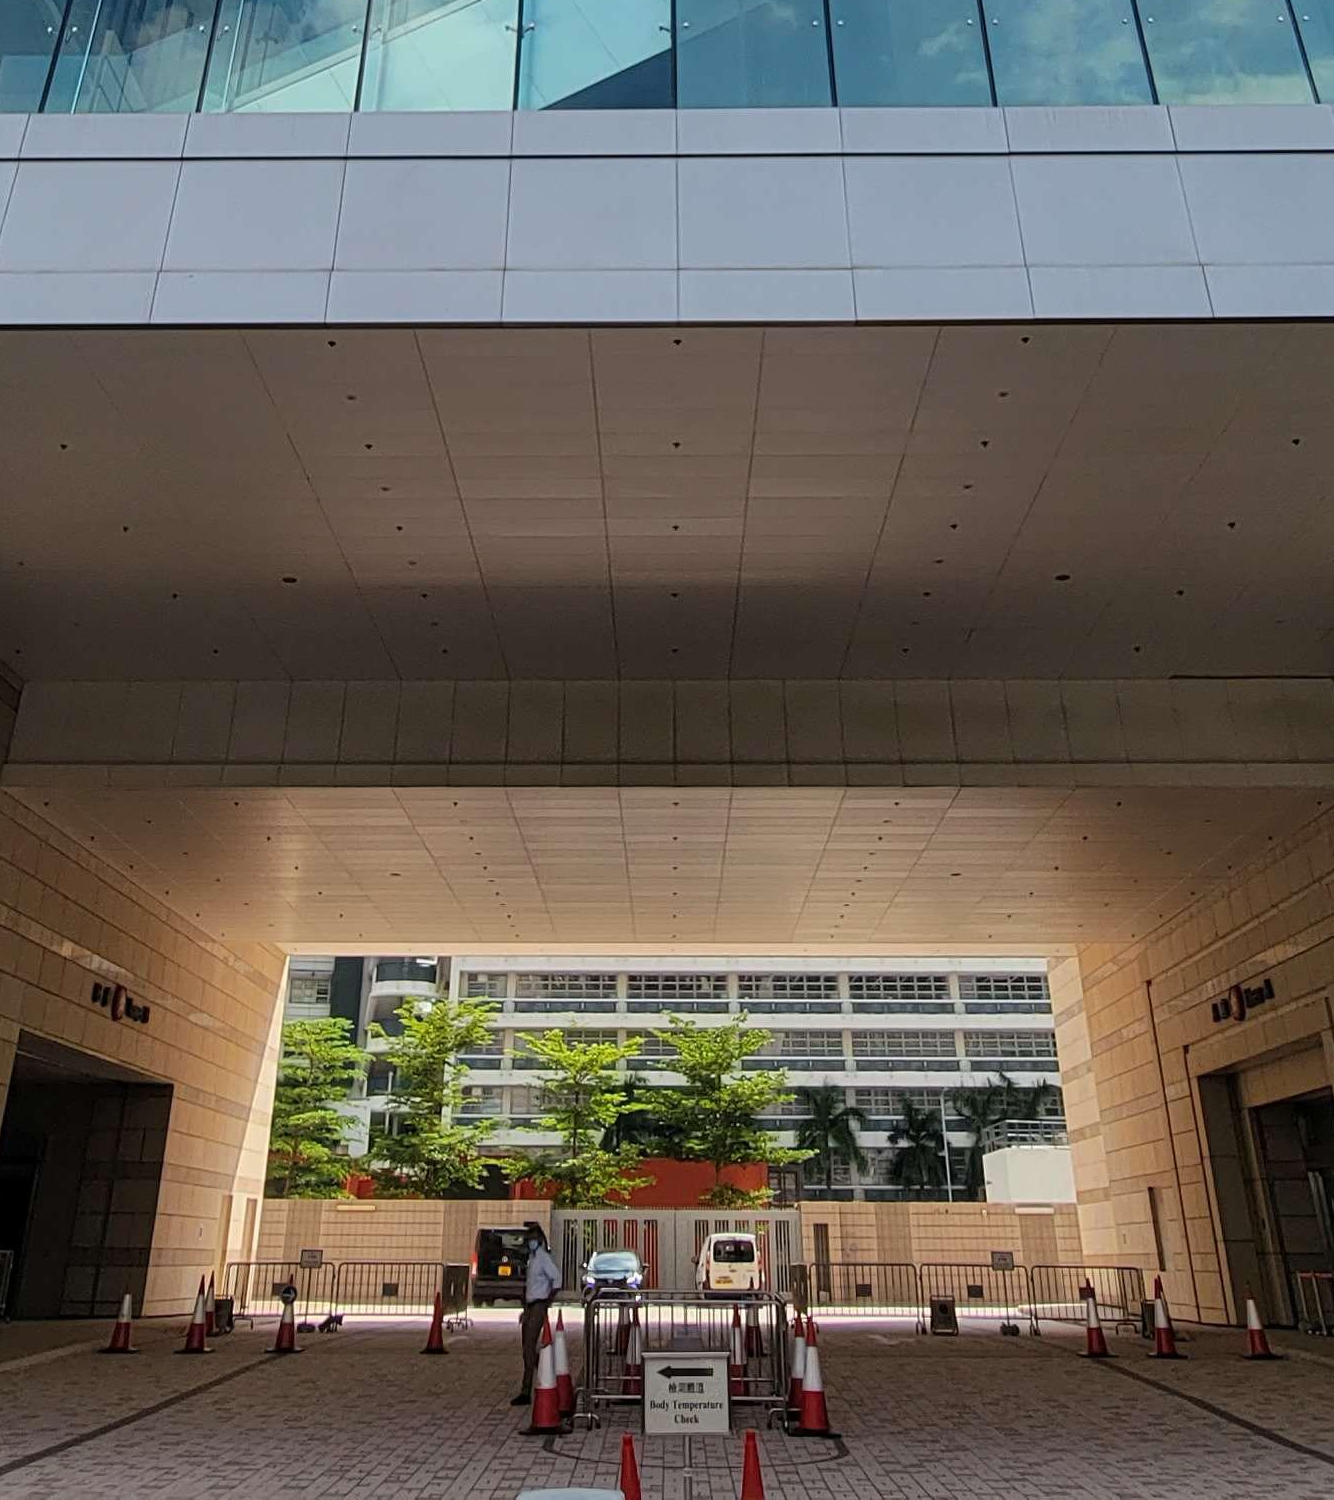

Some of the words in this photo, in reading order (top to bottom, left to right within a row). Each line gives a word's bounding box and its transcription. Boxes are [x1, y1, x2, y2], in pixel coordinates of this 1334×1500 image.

[650, 1400, 669, 1412] Body
[673, 1400, 724, 1412] Temperature
[674, 1414, 700, 1424] Check
